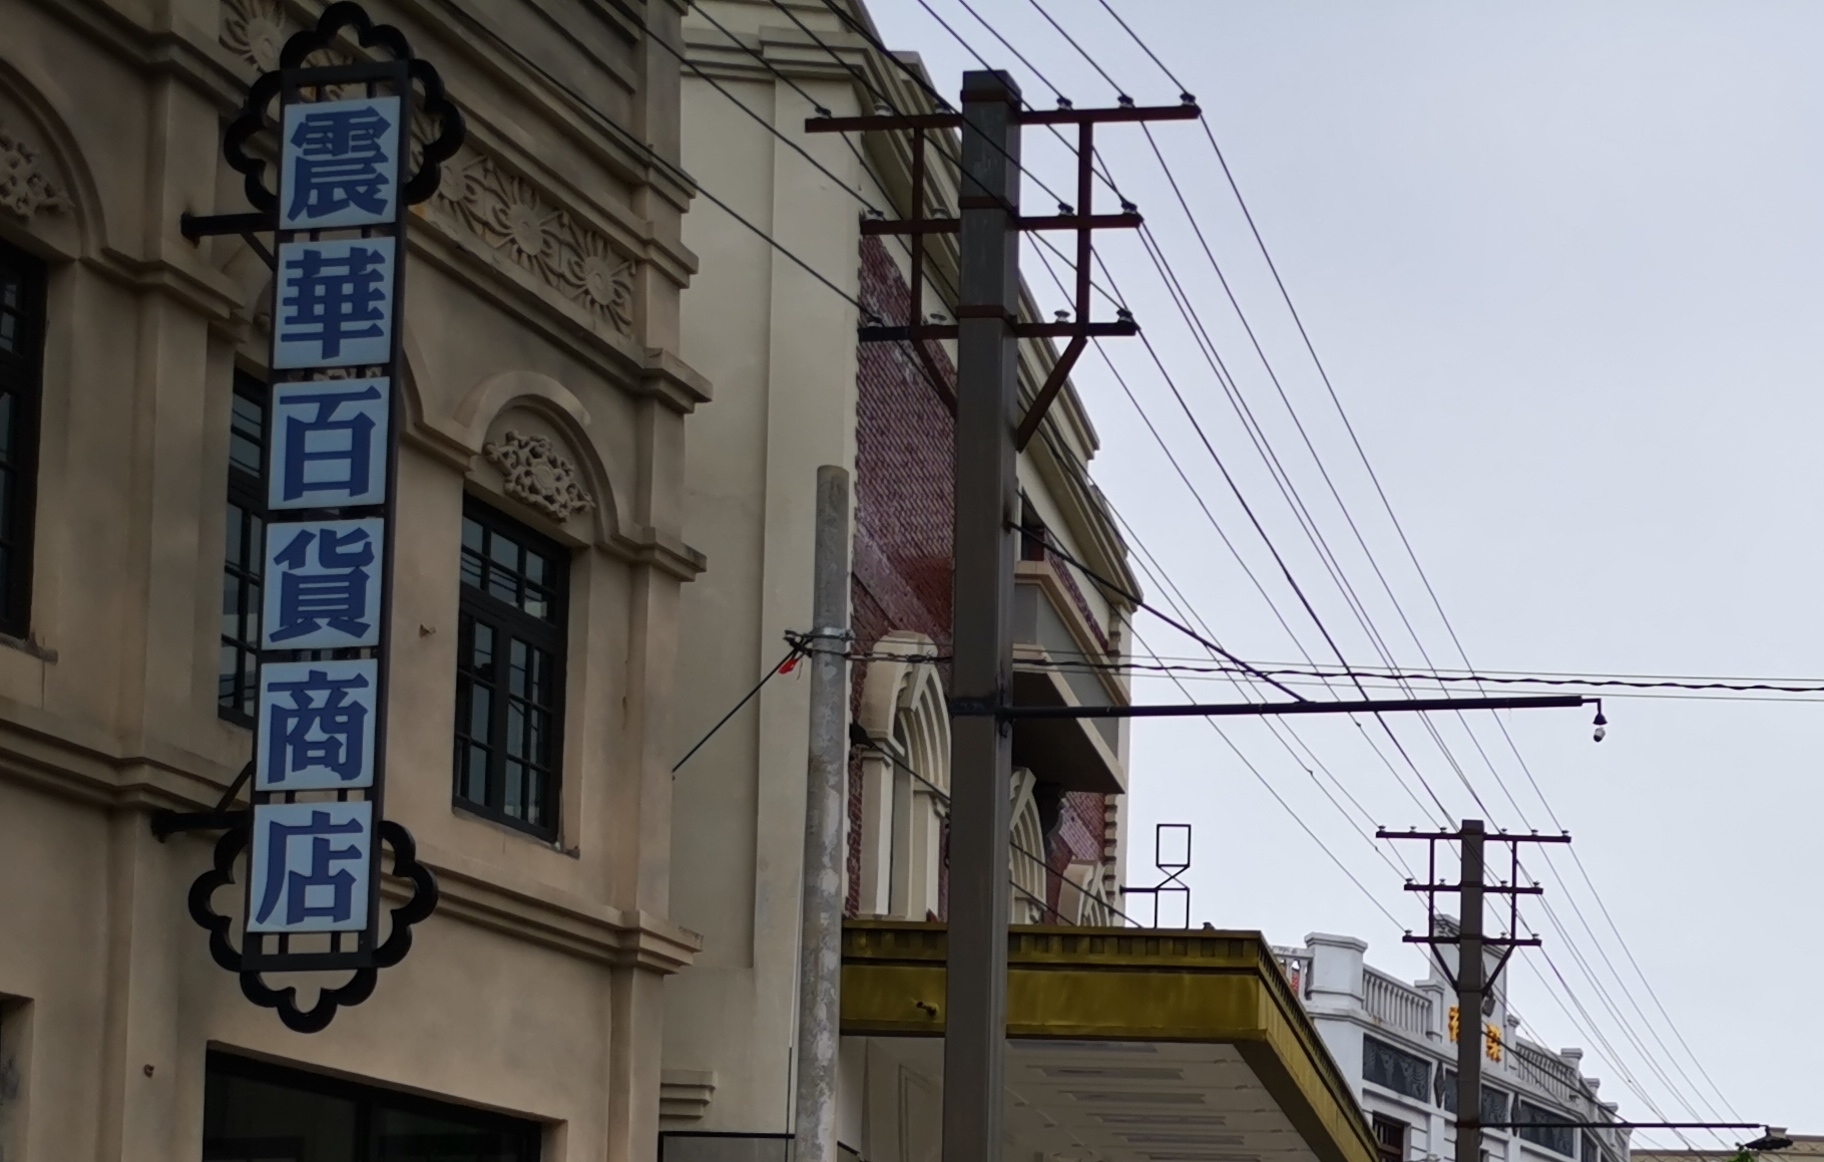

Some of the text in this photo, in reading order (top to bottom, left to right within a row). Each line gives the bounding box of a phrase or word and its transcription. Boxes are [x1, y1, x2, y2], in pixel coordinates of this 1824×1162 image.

[255, 106, 391, 925] 震華百貨商店
